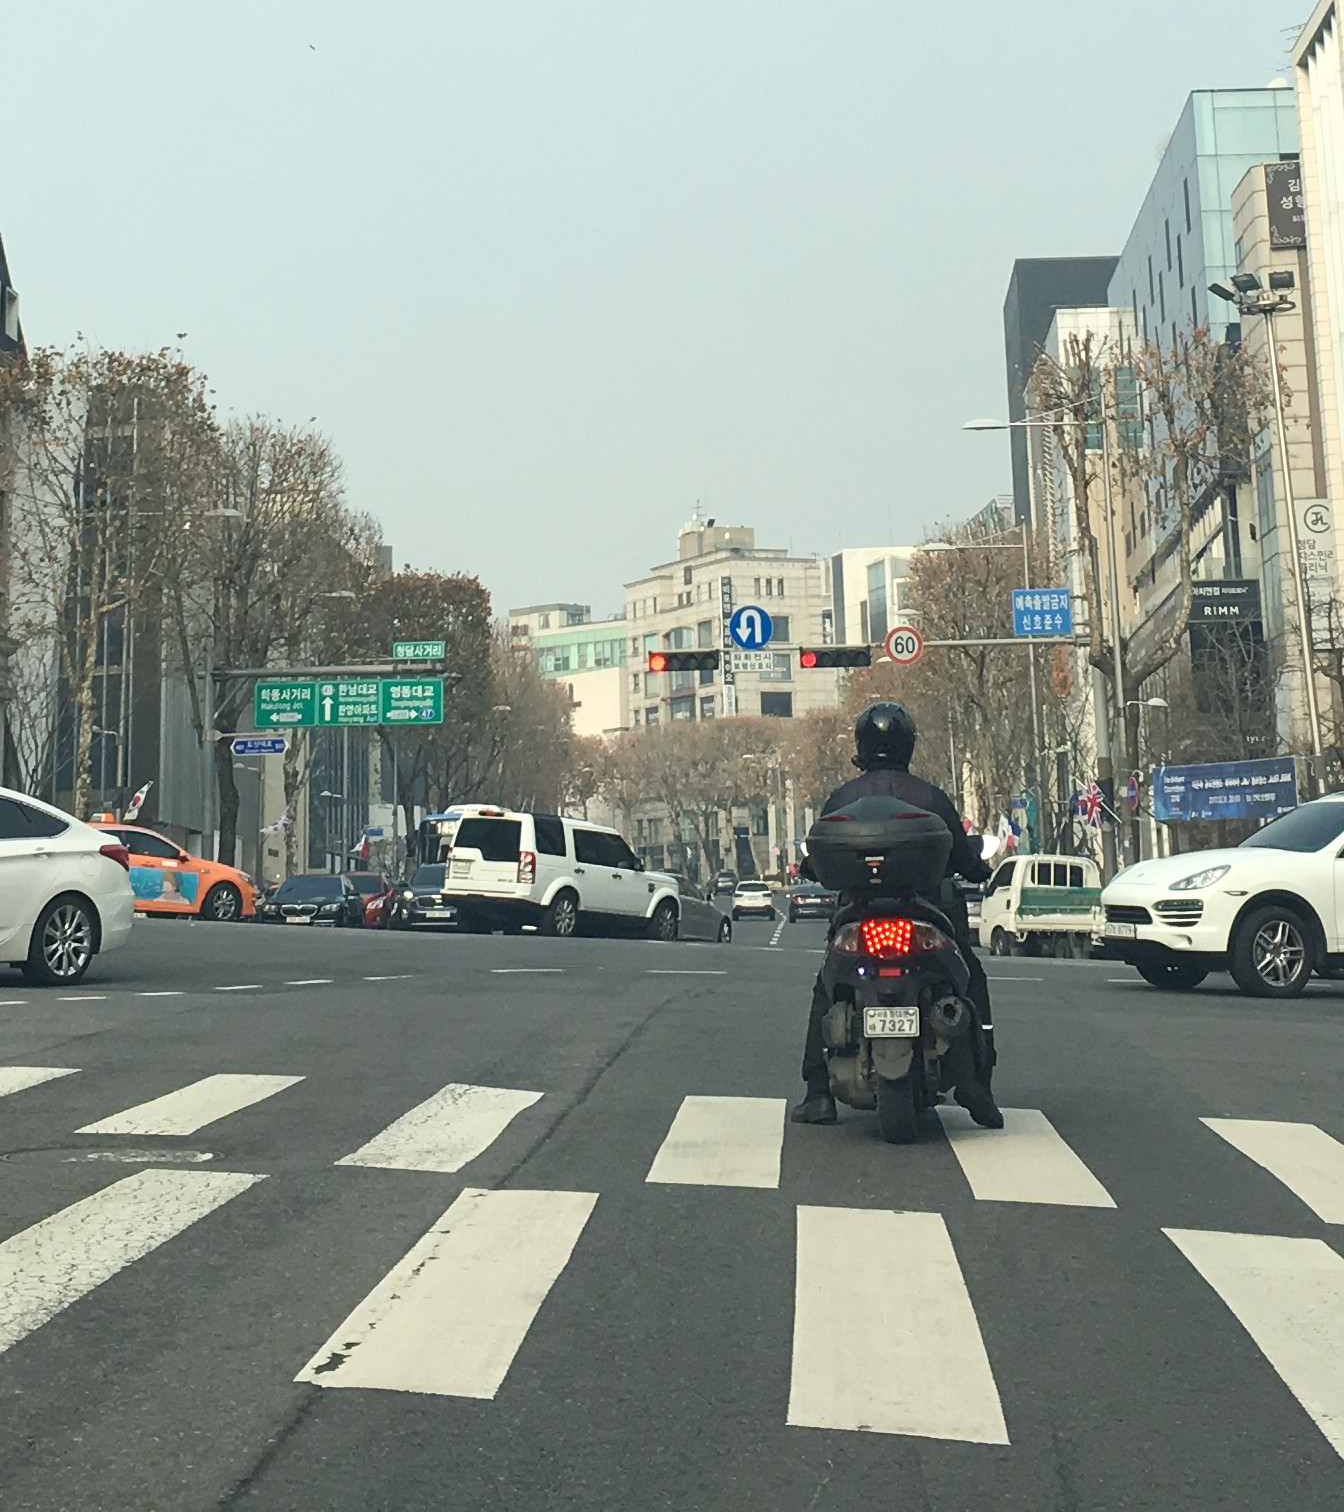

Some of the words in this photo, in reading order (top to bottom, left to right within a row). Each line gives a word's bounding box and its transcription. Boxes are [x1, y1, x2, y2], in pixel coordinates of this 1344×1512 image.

[1015, 594, 1069, 611] 예측출발금지
[1203, 605, 1240, 616] RIMM
[1022, 614, 1064, 631] 신호준수
[396, 644, 442, 657] 청담사거리
[894, 636, 916, 655] 60
[338, 683, 377, 696] 한남대교
[390, 685, 434, 698] 영동대교
[879, 1018, 914, 1033] 7327
